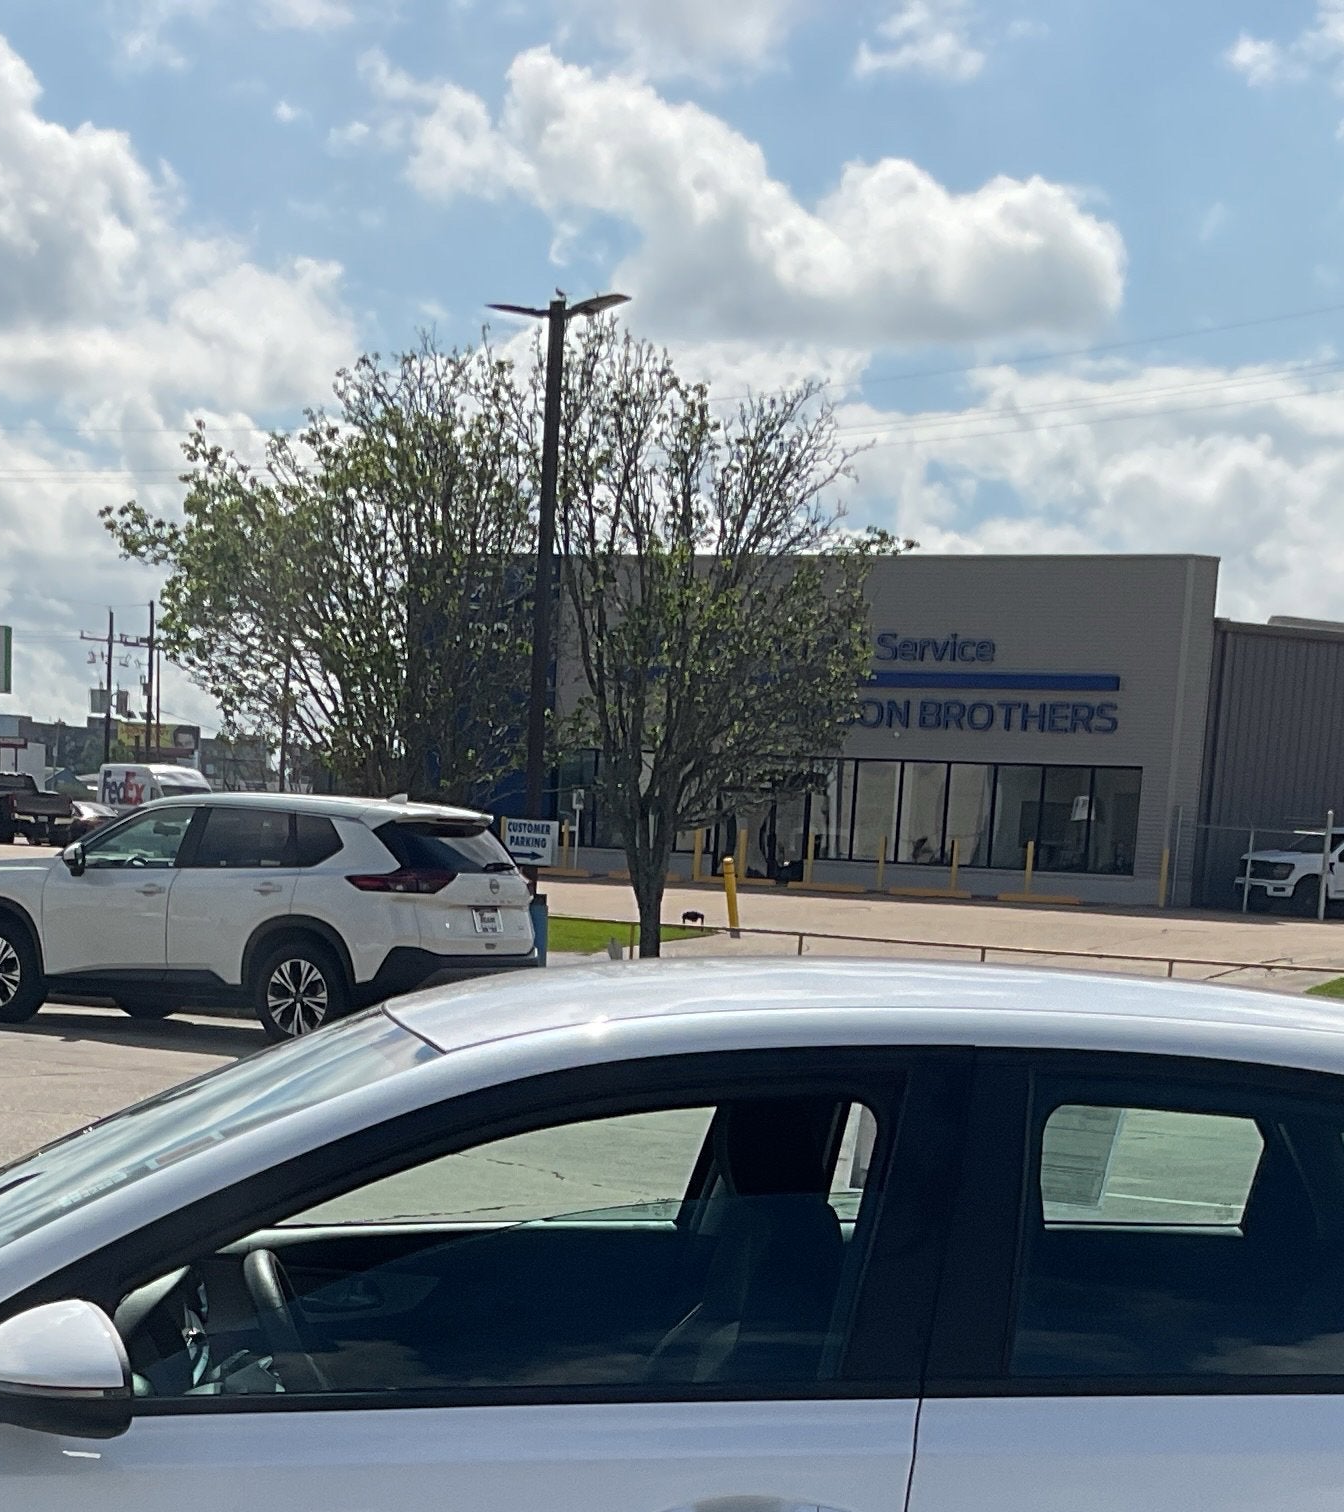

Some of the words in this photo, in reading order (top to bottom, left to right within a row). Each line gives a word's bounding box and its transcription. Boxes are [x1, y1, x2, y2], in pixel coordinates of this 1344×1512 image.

[875, 633, 997, 663] Service
[918, 701, 1119, 734] BROTHERS
[102, 770, 144, 805] FedEx
[507, 821, 551, 835] CUSTOMER
[509, 835, 547, 848] PARKING
